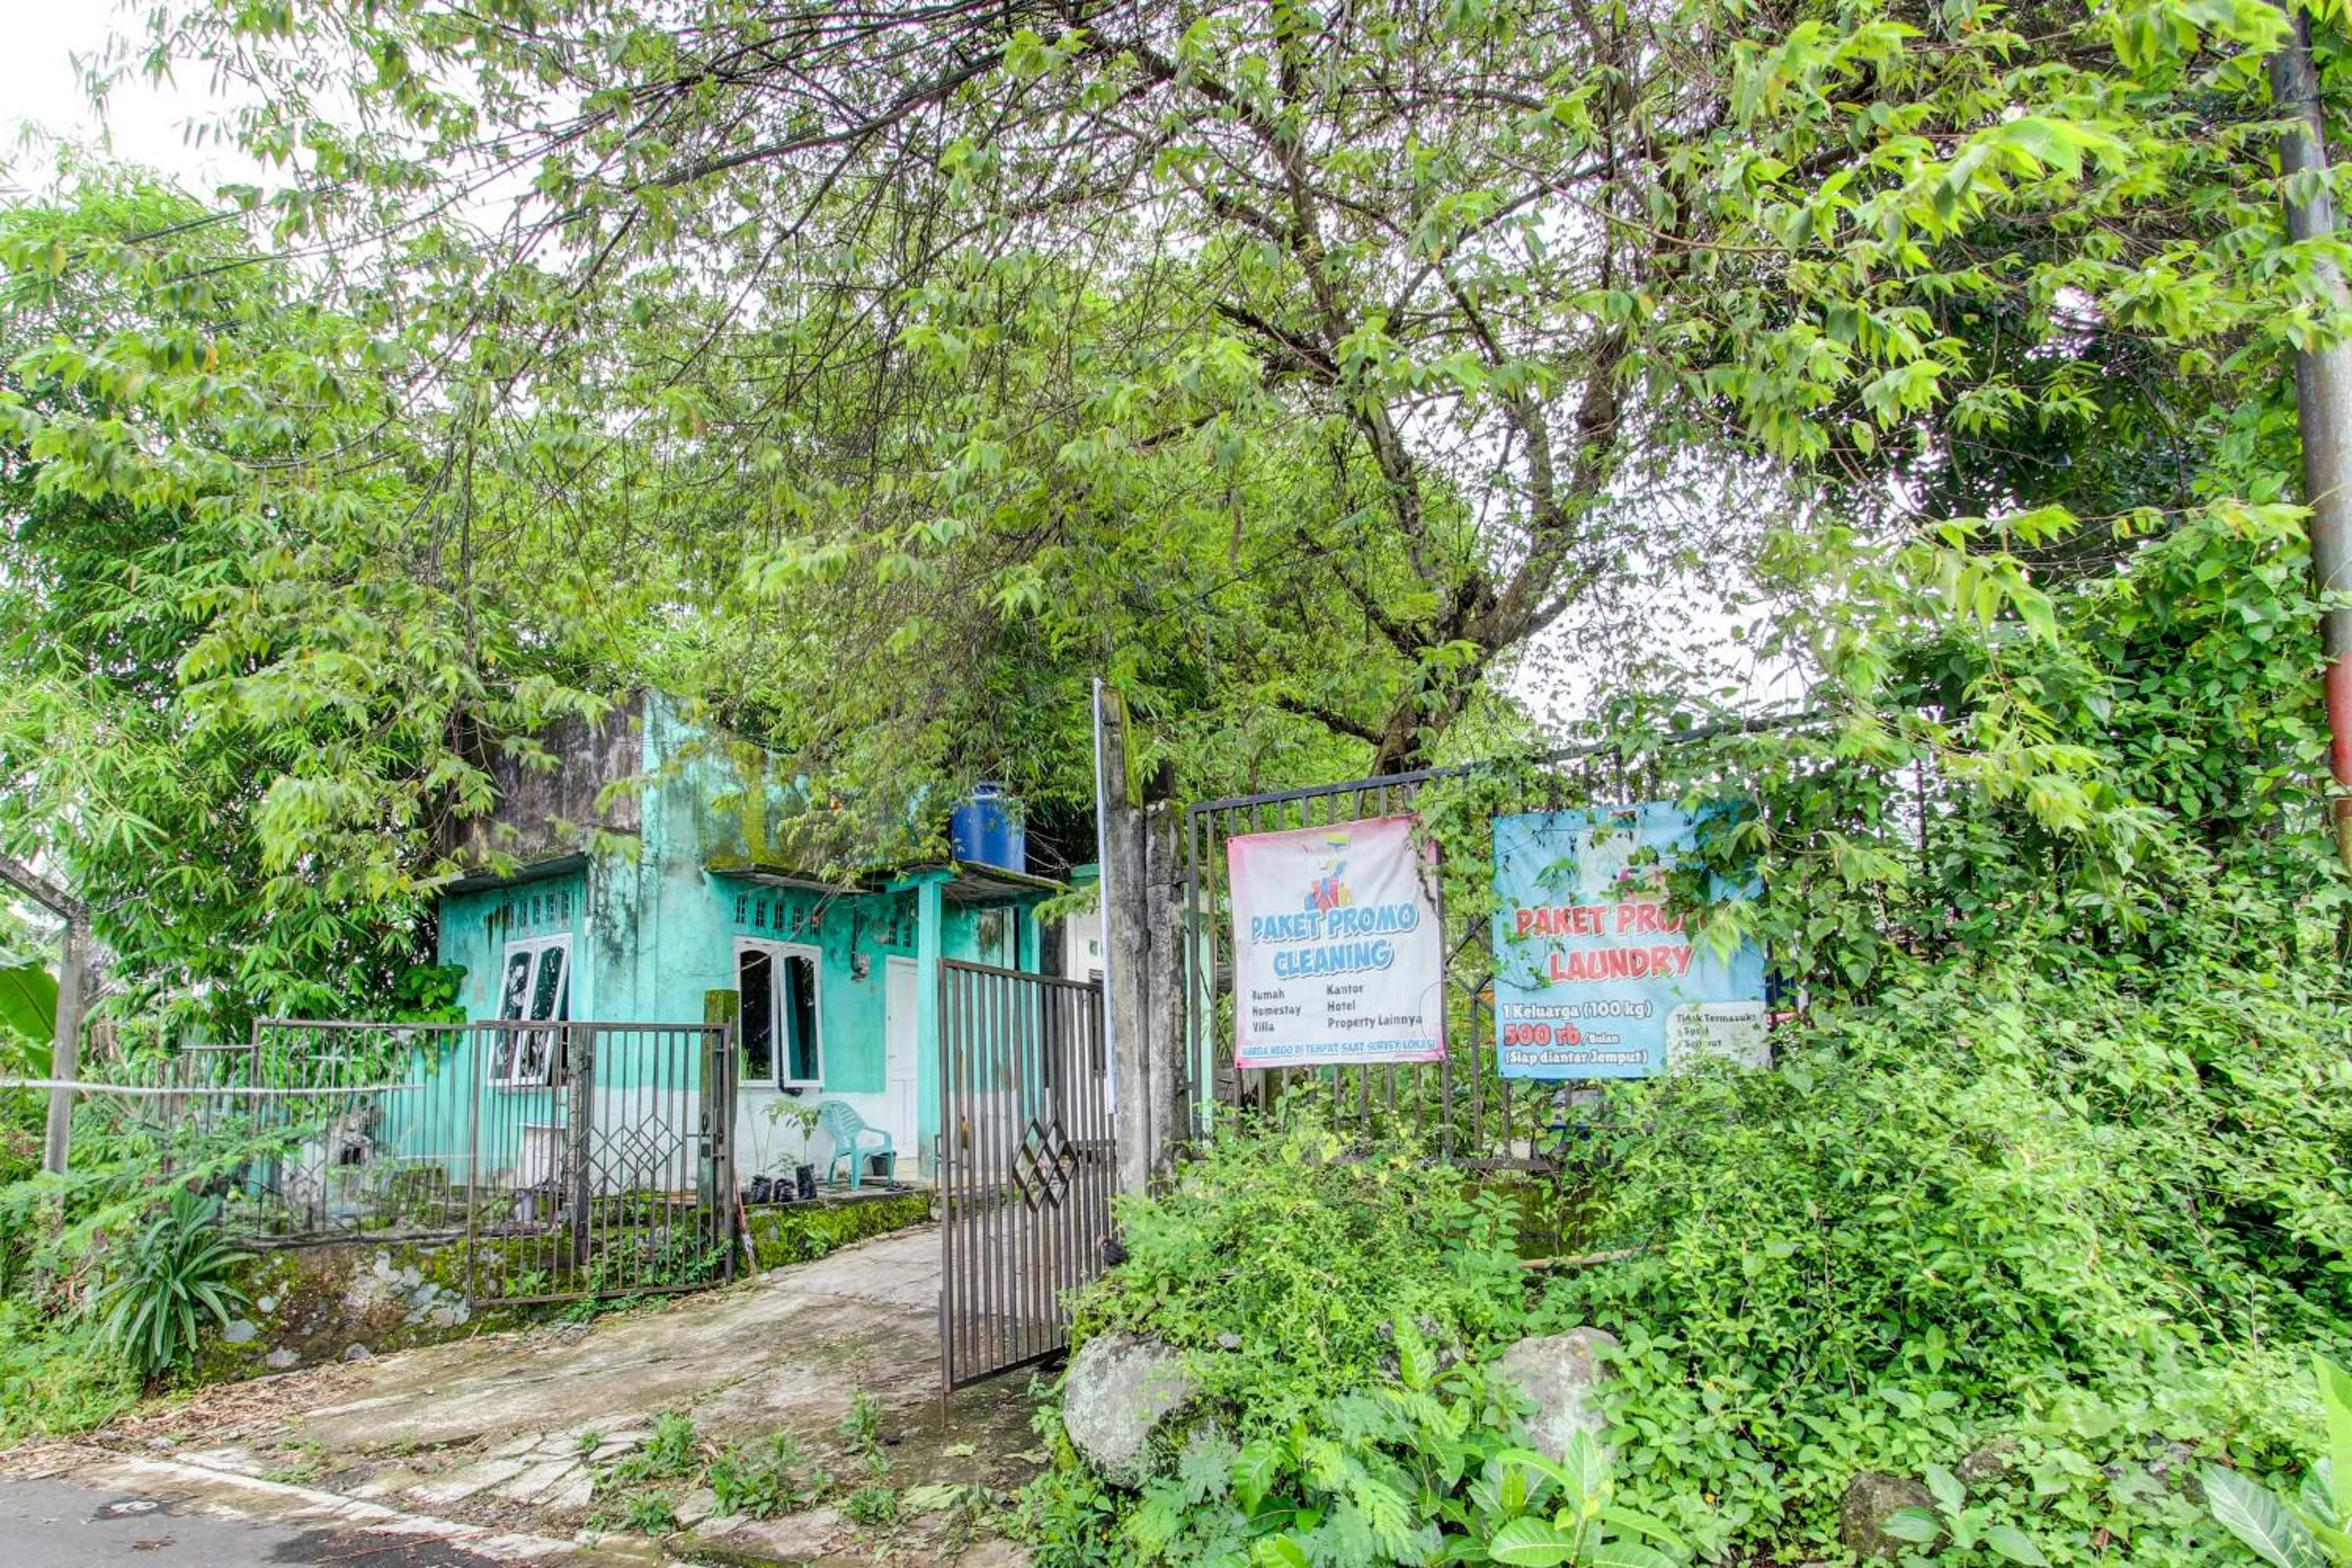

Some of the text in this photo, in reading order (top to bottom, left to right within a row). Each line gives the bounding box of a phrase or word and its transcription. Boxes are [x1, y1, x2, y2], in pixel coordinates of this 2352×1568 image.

[1252, 903, 1417, 942] PAKET PROMO
[1515, 902, 1708, 938] PAKET PRO
[1274, 940, 1393, 978] CLEANING
[1549, 944, 1694, 983] LAUNDRY
[1251, 989, 1285, 1001] Rumah
[1327, 984, 1364, 996] Kantor
[1252, 1004, 1301, 1017] Homestay
[1327, 1000, 1356, 1012] Hotel
[1503, 1004, 1510, 1018] 1
[1512, 1003, 1580, 1019] Keluarga
[1252, 1021, 1275, 1033] Villa
[1328, 1014, 1423, 1029] Property Lainnya
[1504, 1023, 1552, 1047] 500
[1555, 1022, 1581, 1046] rb
[1540, 1049, 1588, 1064] diantar
